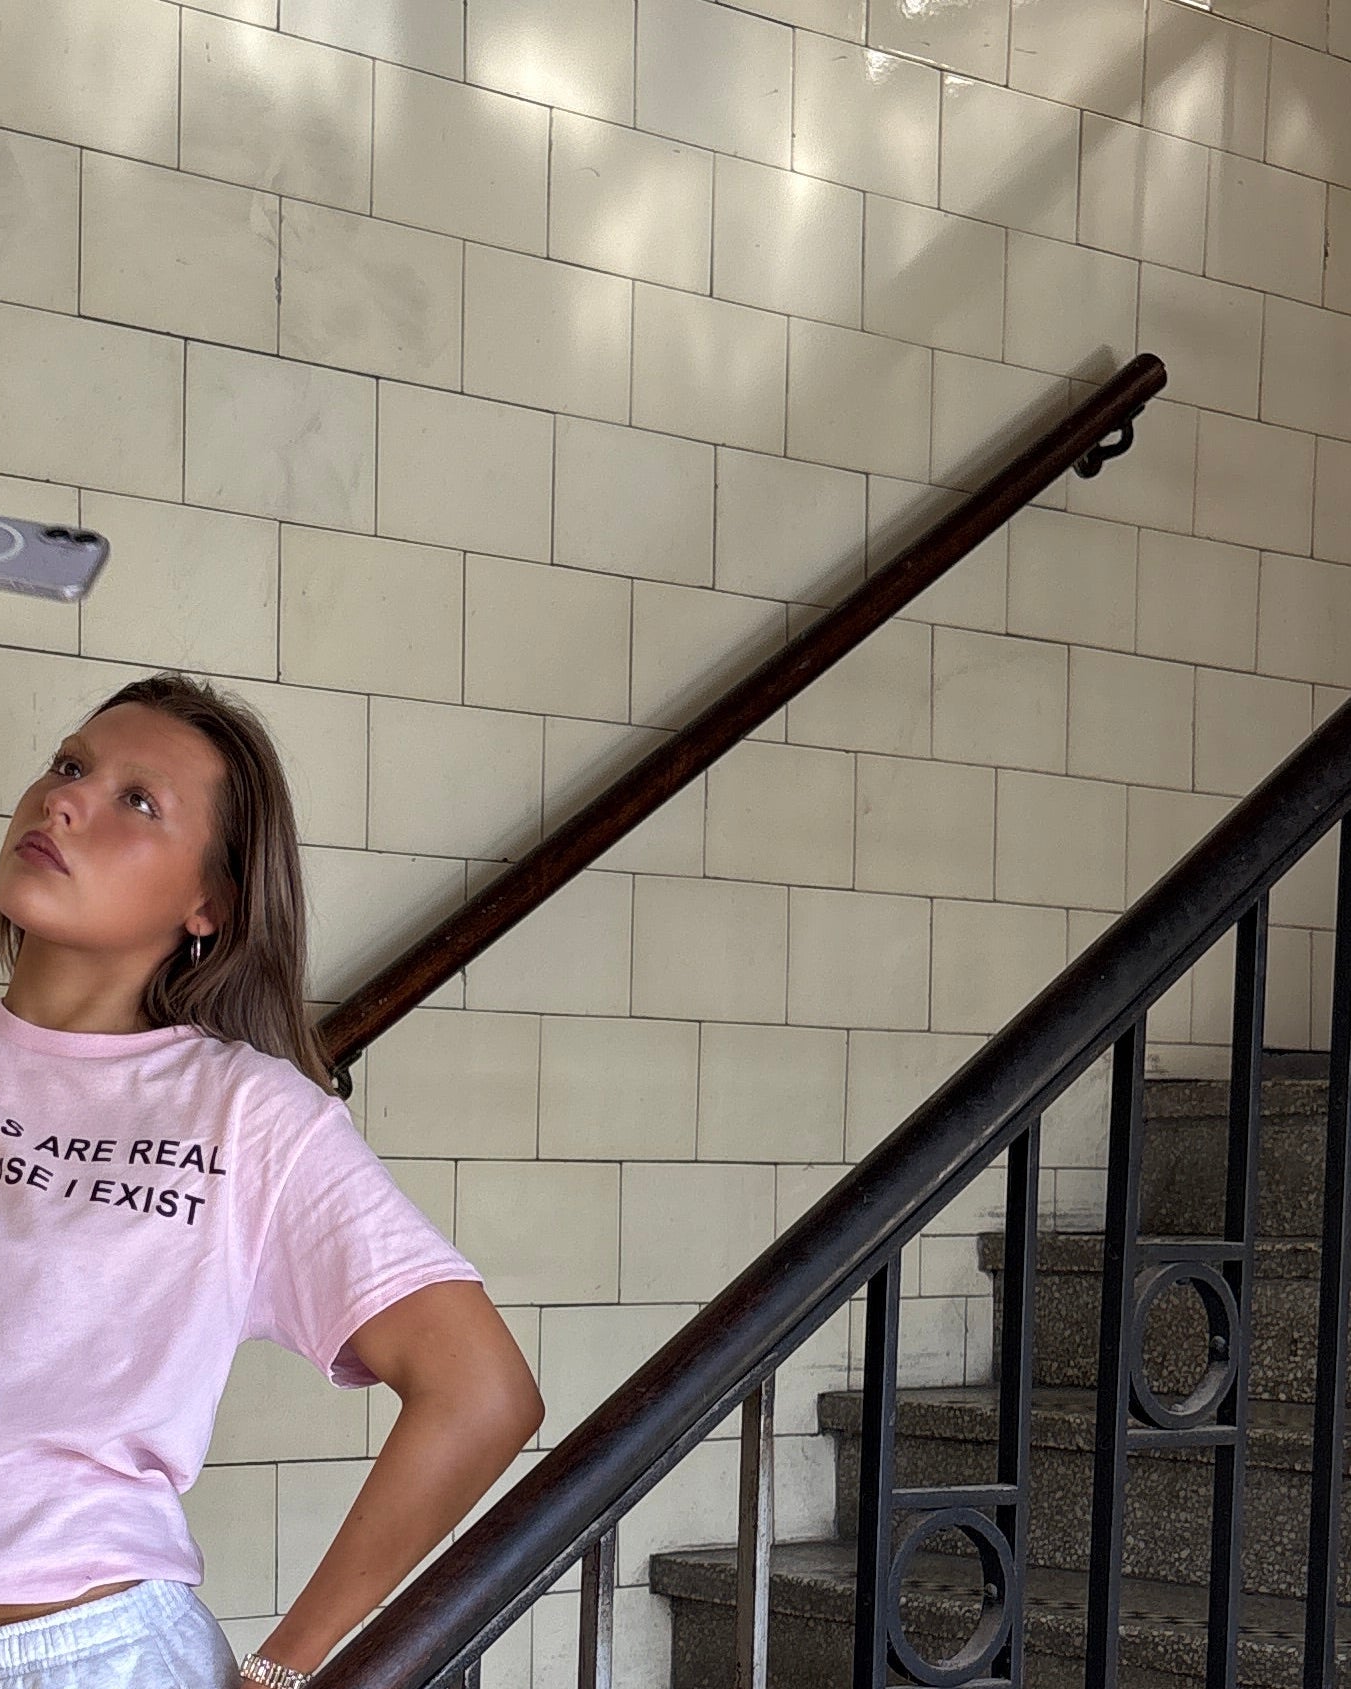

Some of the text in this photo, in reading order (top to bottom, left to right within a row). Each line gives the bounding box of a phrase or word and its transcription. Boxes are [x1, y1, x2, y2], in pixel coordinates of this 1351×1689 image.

[34, 1135, 117, 1163] ARE
[128, 1140, 227, 1176] REAL
[64, 1179, 78, 1198] I
[90, 1179, 206, 1226] EXIST
